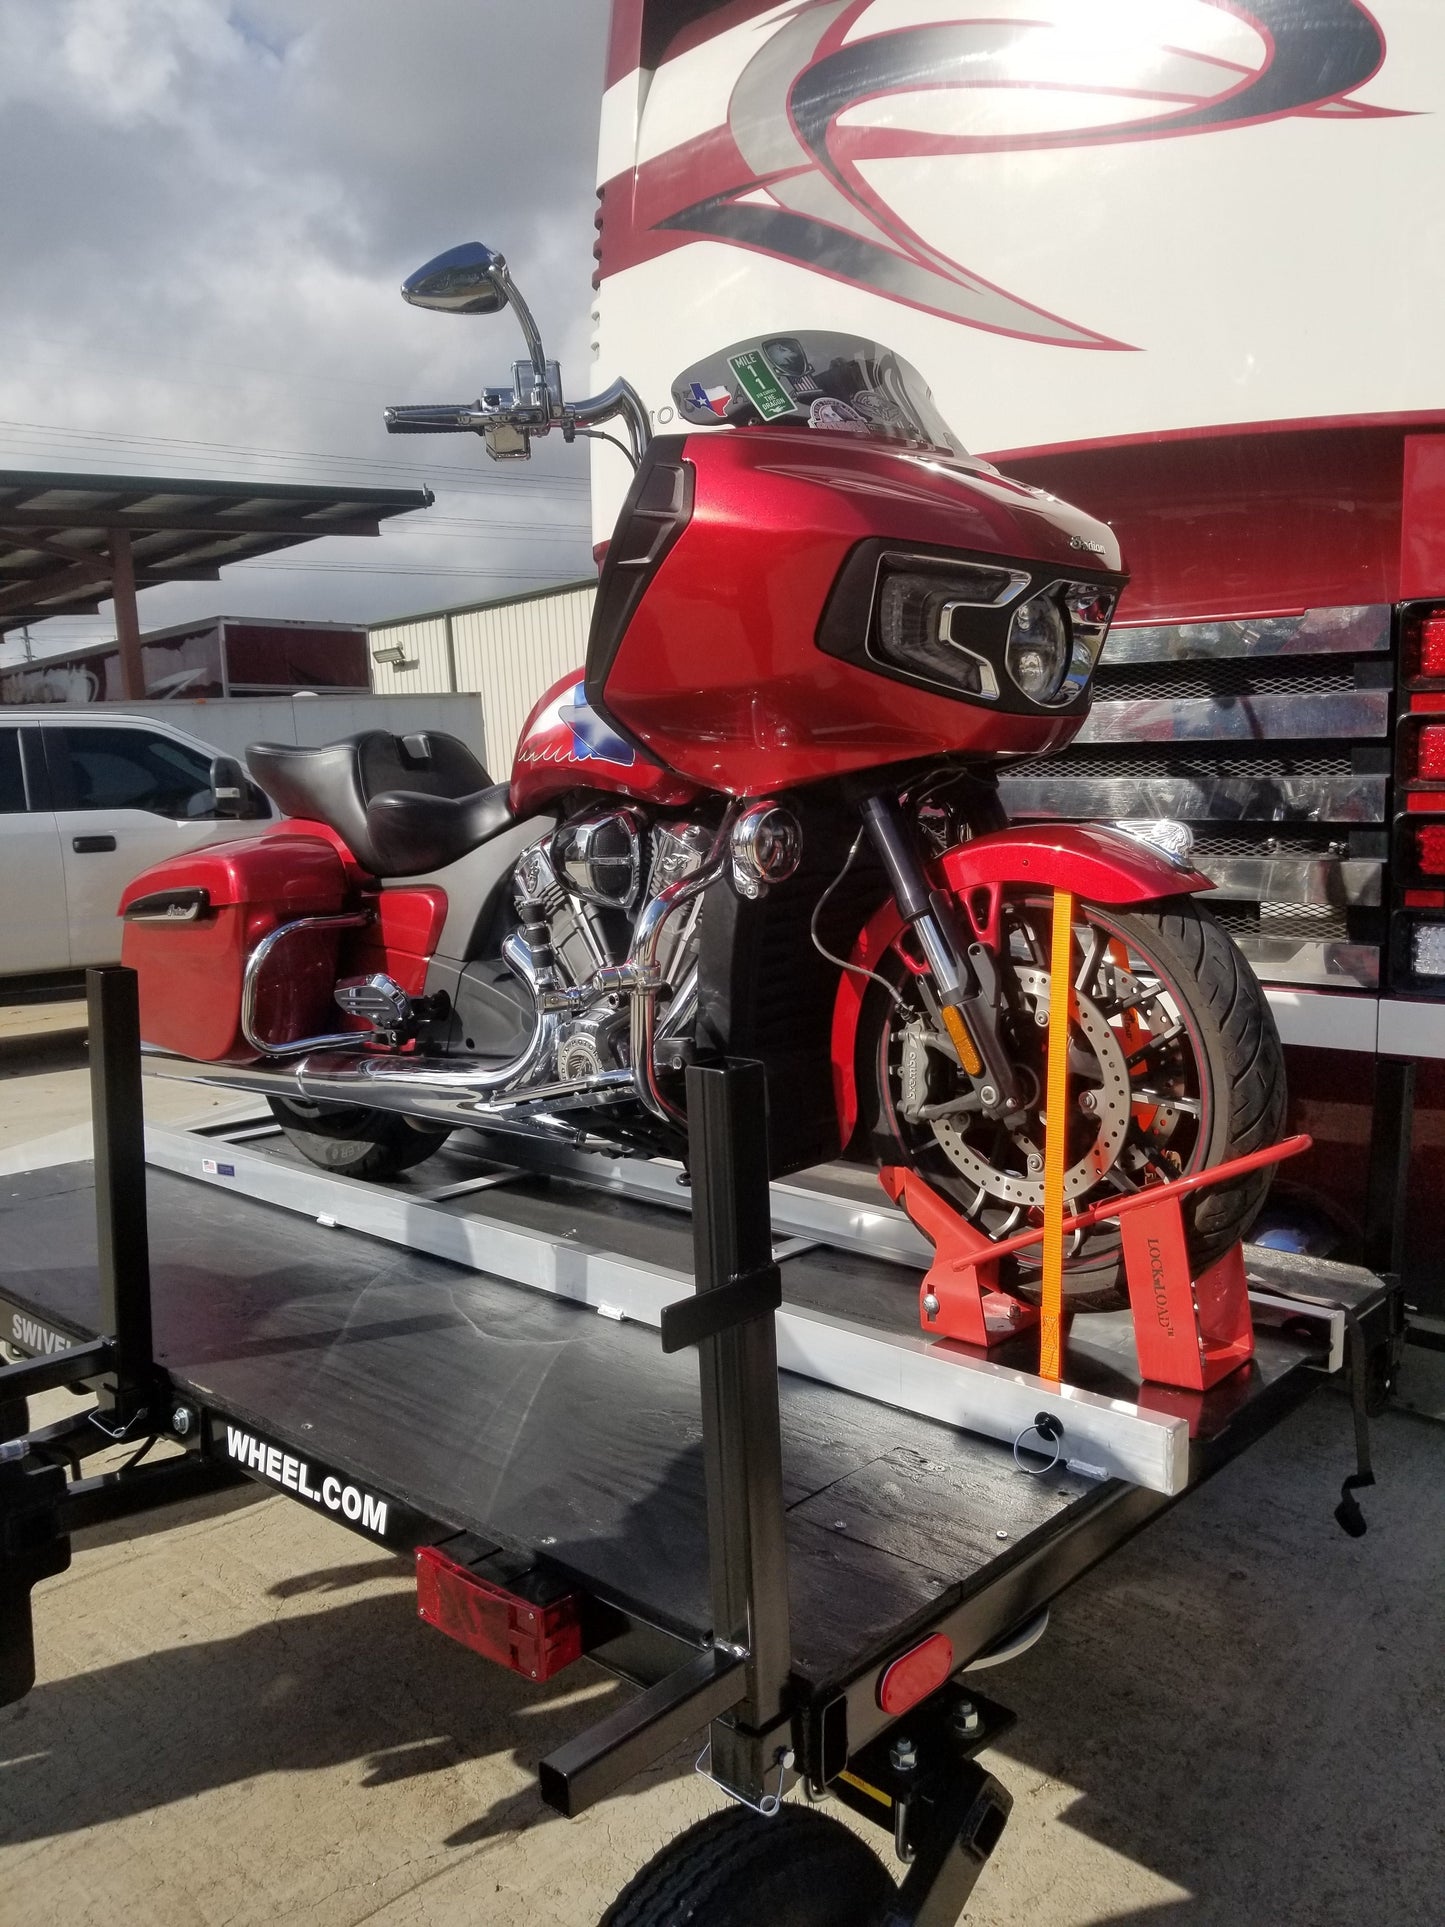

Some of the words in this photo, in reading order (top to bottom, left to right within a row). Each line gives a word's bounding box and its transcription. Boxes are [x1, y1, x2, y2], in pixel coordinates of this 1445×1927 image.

[734, 354, 757, 368] MILE
[762, 398, 786, 410] DRAGON
[764, 394, 776, 402] THE
[907, 1052, 917, 1101] brembo
[226, 1426, 388, 1535] WHEEL.COM
